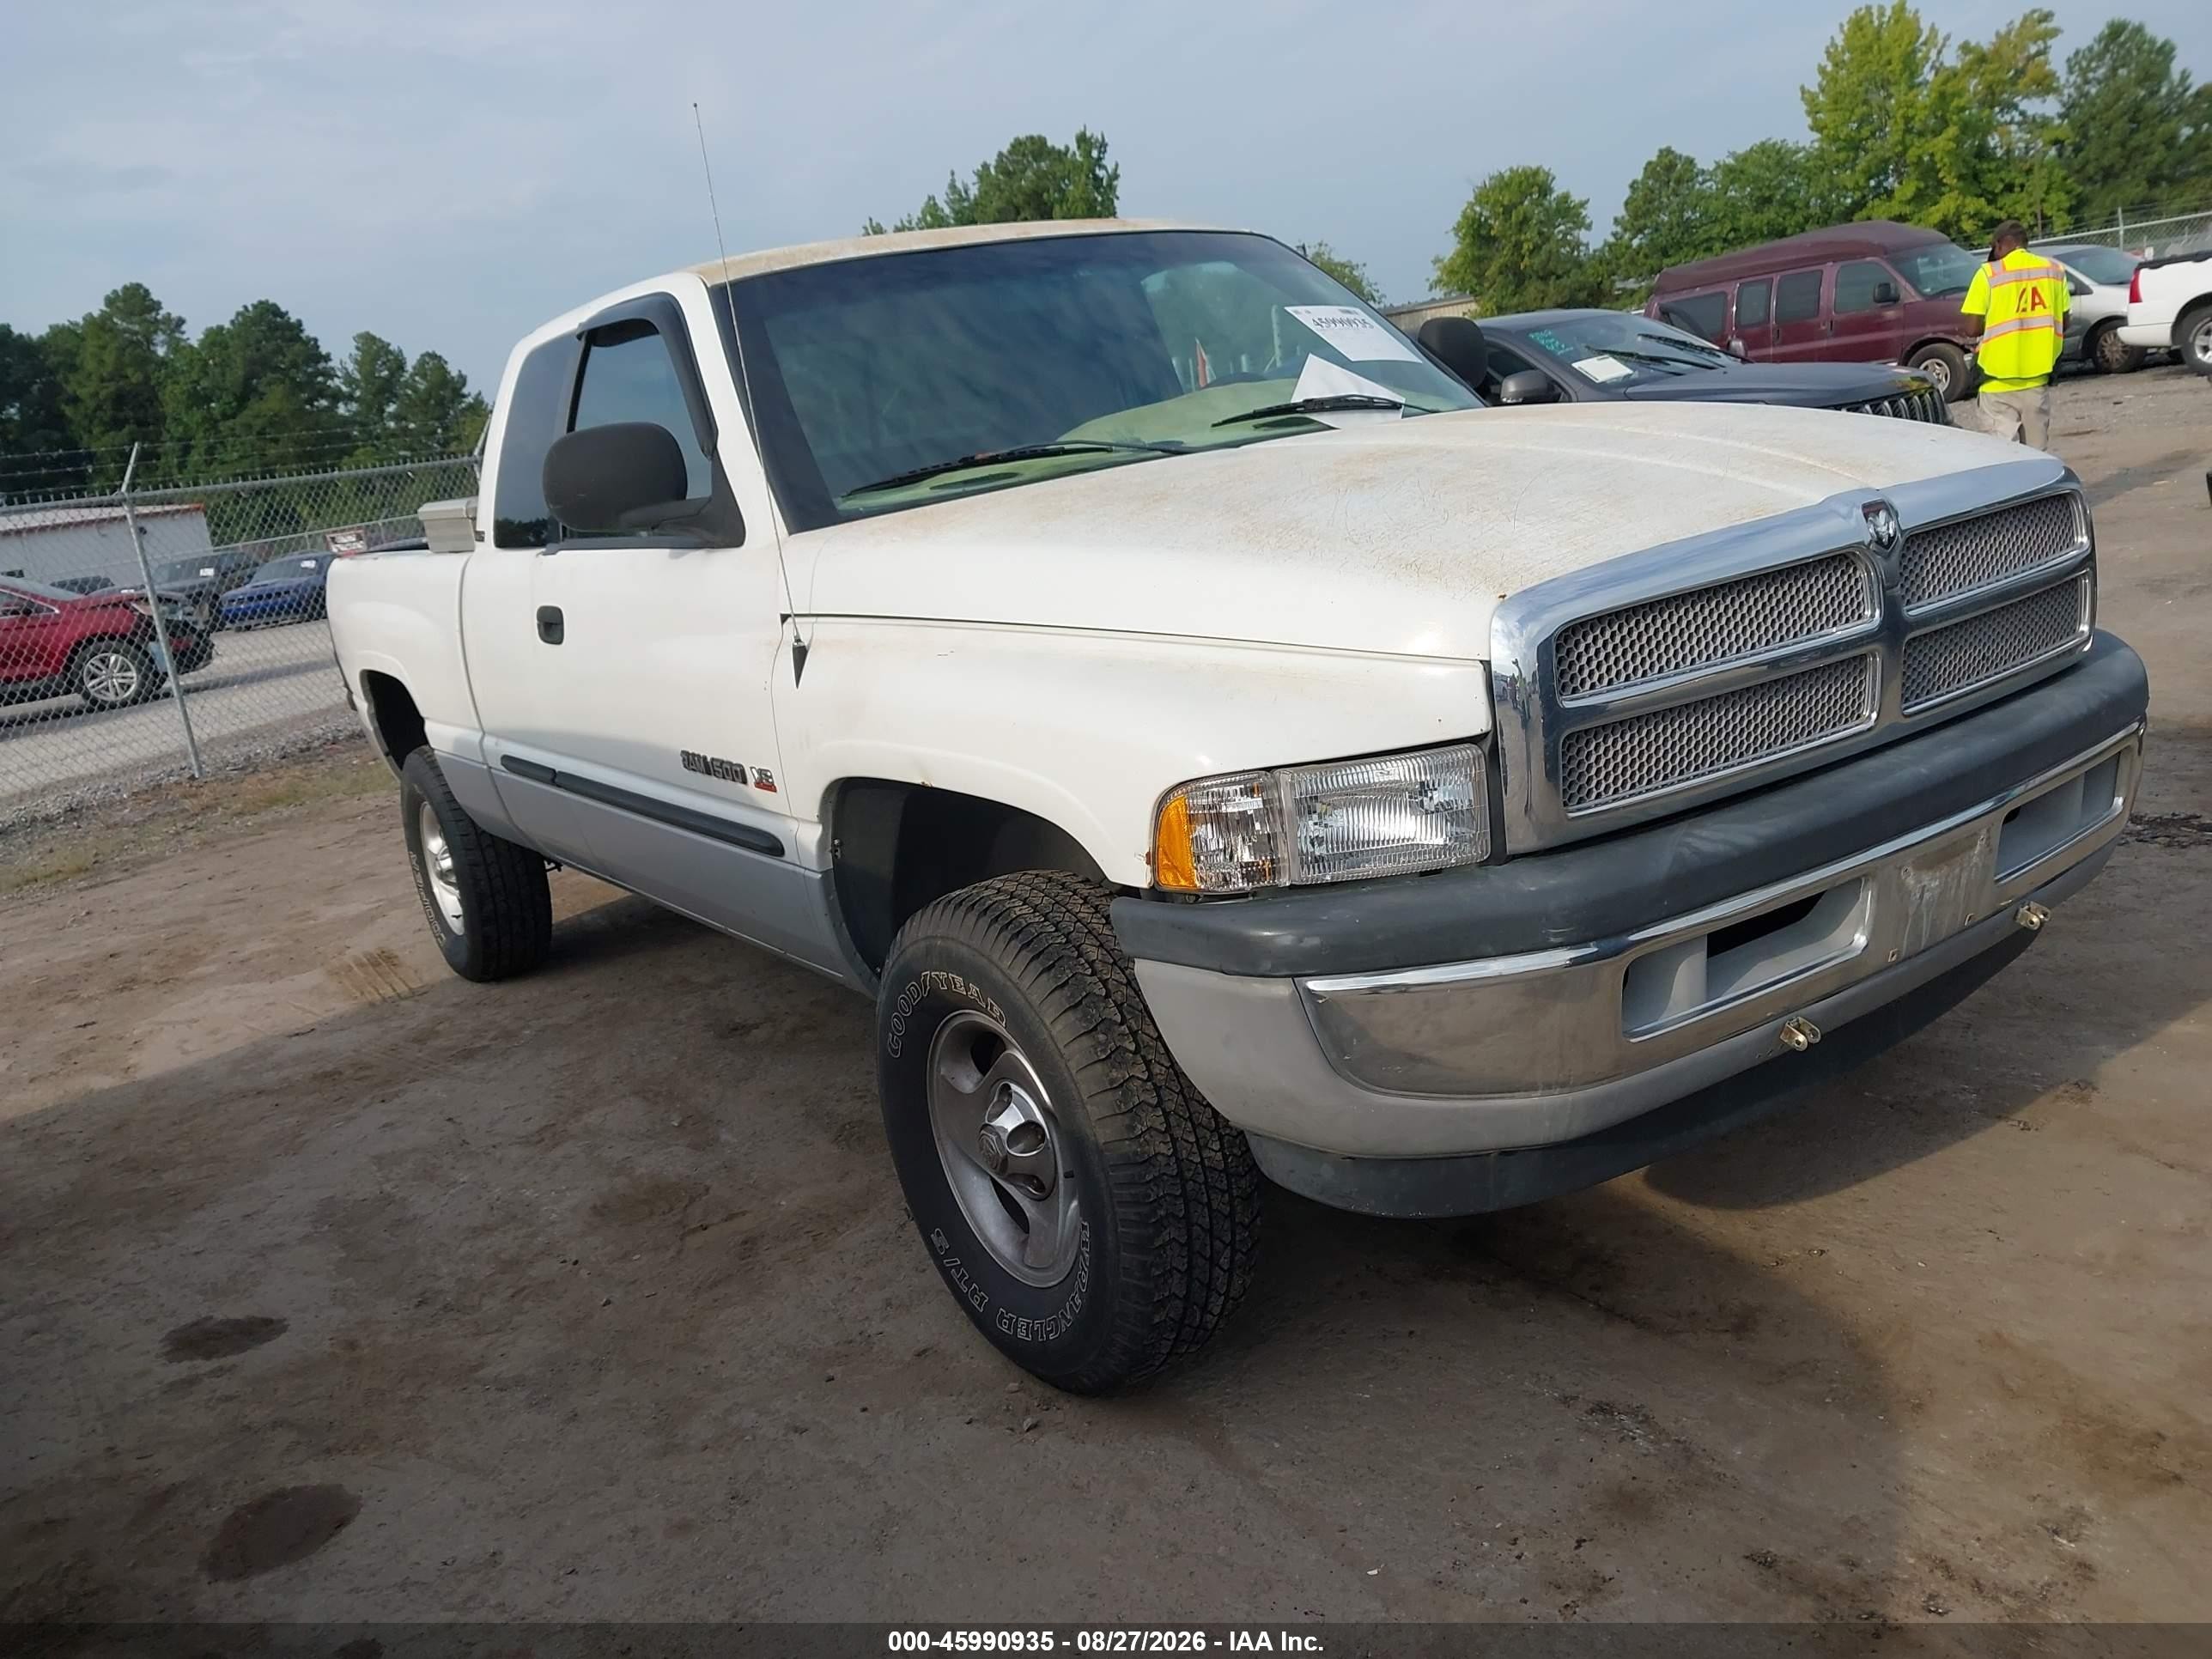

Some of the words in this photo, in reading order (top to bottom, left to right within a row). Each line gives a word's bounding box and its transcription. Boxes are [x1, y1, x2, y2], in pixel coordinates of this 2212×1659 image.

[680, 750, 711, 775] RAM
[707, 757, 748, 785] 1500
[888, 971, 1006, 1058] GOODYEAR
[932, 1229, 988, 1312] RT/S
[996, 1221, 1091, 1341] WRANGLER
